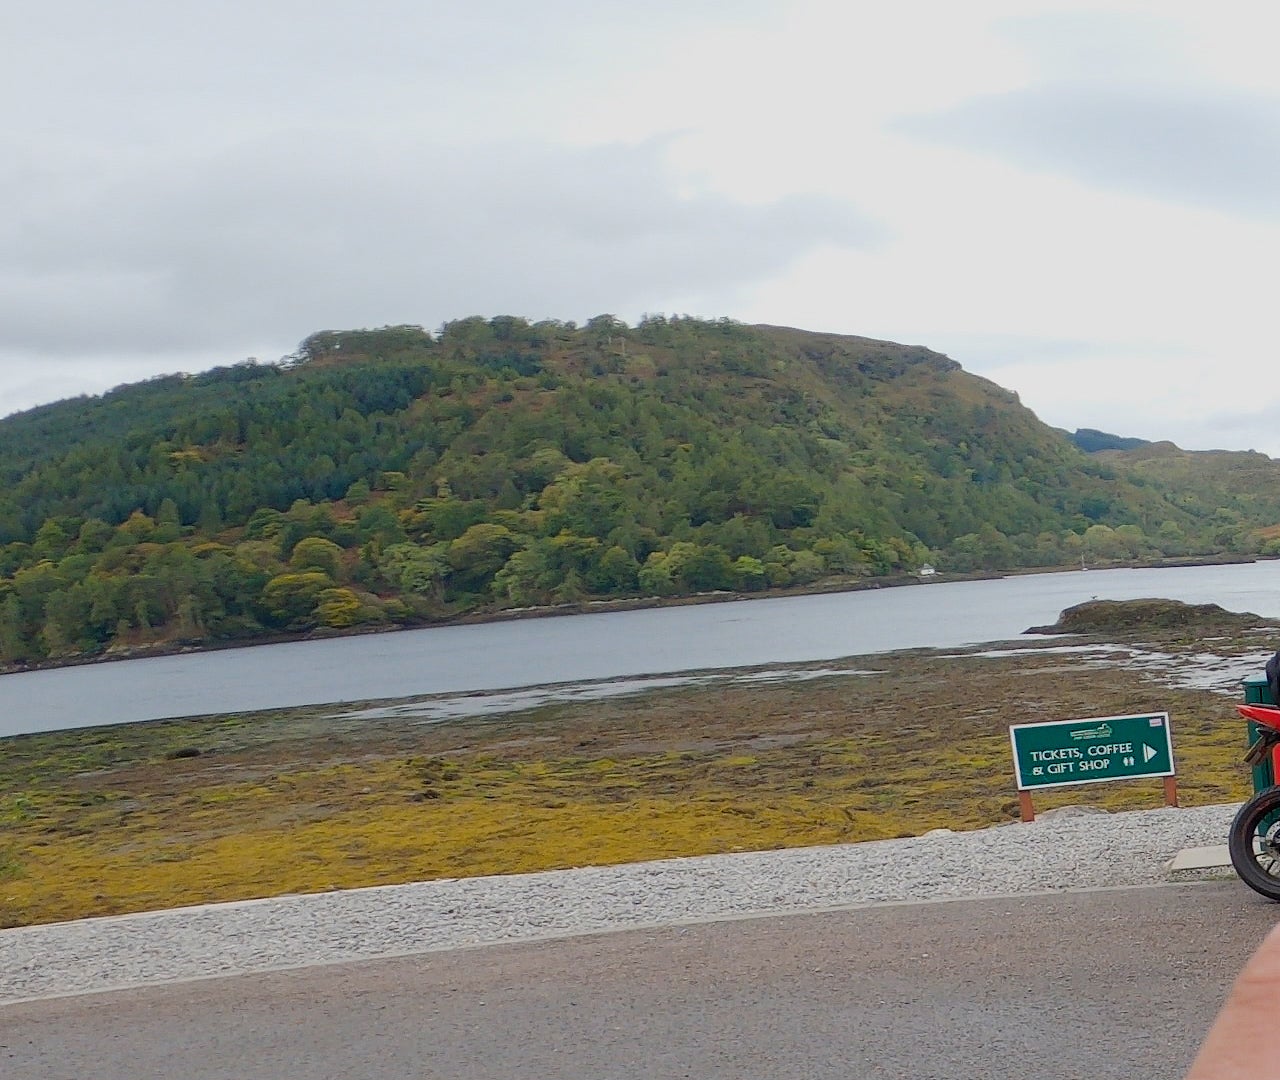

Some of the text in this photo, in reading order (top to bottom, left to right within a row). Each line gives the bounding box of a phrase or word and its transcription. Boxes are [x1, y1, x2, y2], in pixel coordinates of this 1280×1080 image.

[1030, 742, 1133, 762] TICKETS, COFFEE
[1032, 758, 1110, 776] & GIFT SHOP
